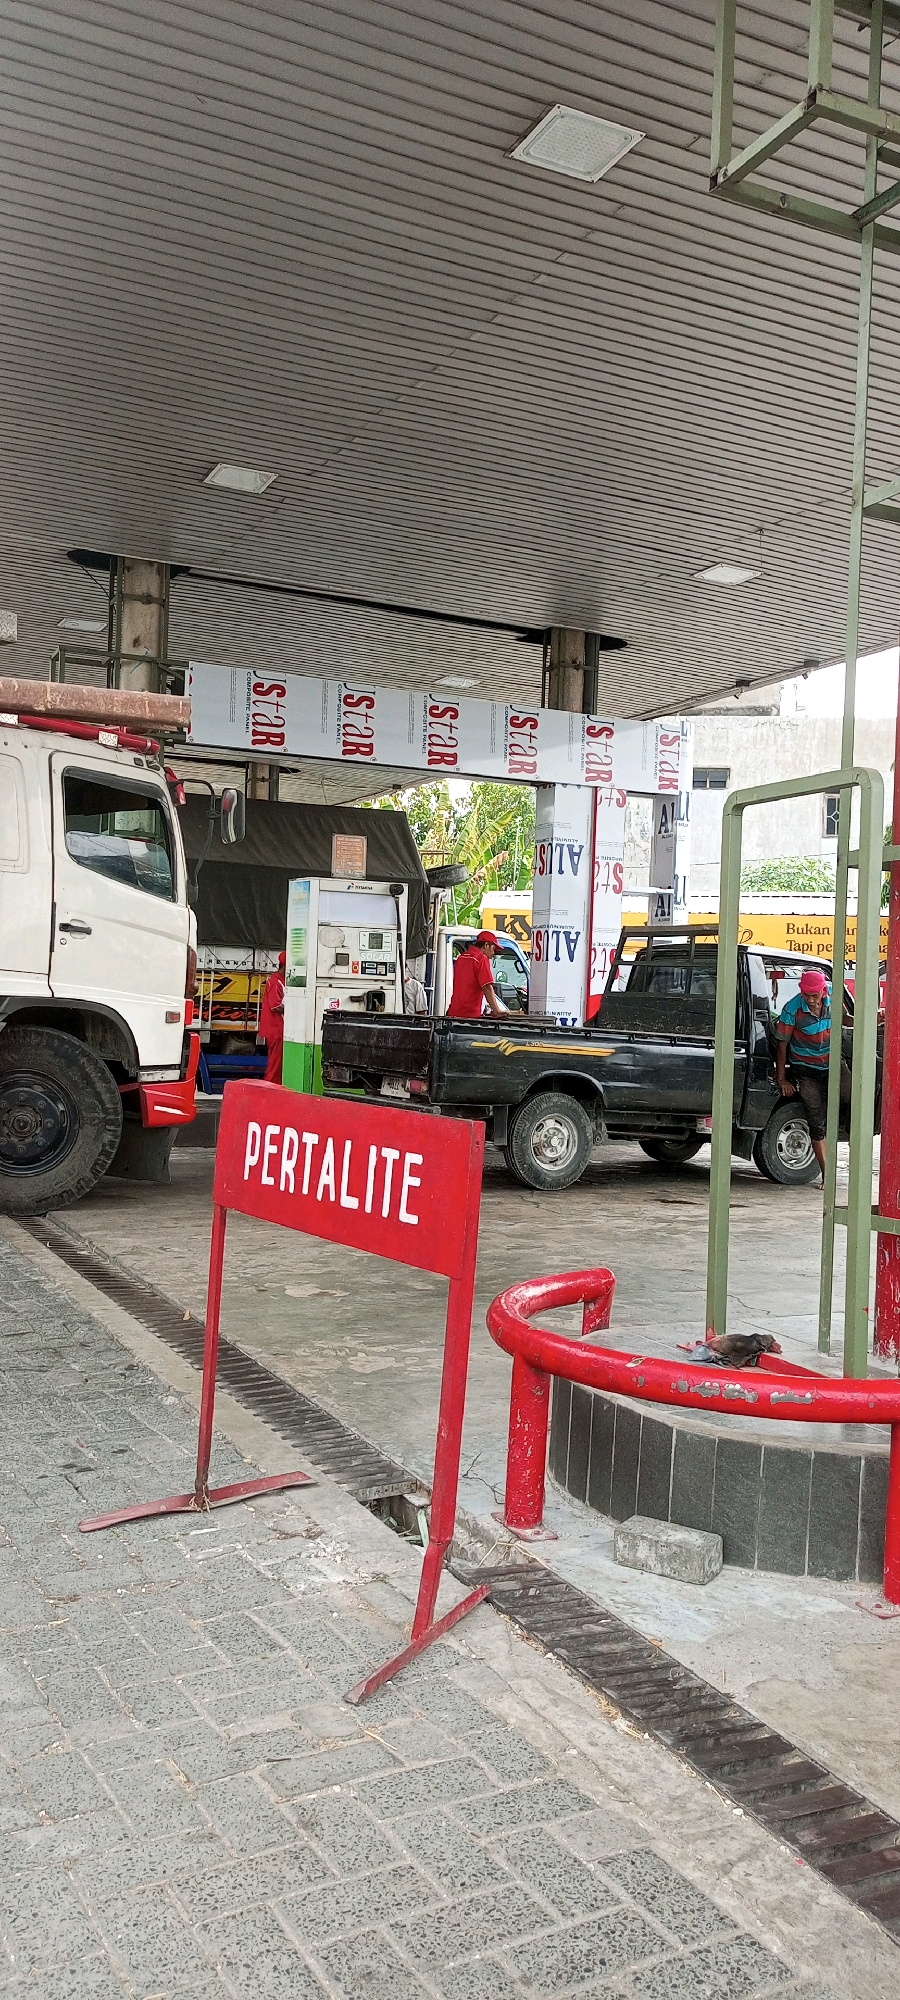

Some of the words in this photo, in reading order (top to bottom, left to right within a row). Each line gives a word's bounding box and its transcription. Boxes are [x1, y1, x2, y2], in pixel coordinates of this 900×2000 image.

[786, 923, 830, 936] Bukan
[786, 939, 813, 954] Tapi
[360, 952, 391, 962] SOLAR
[243, 1121, 423, 1225] PERTALITE
